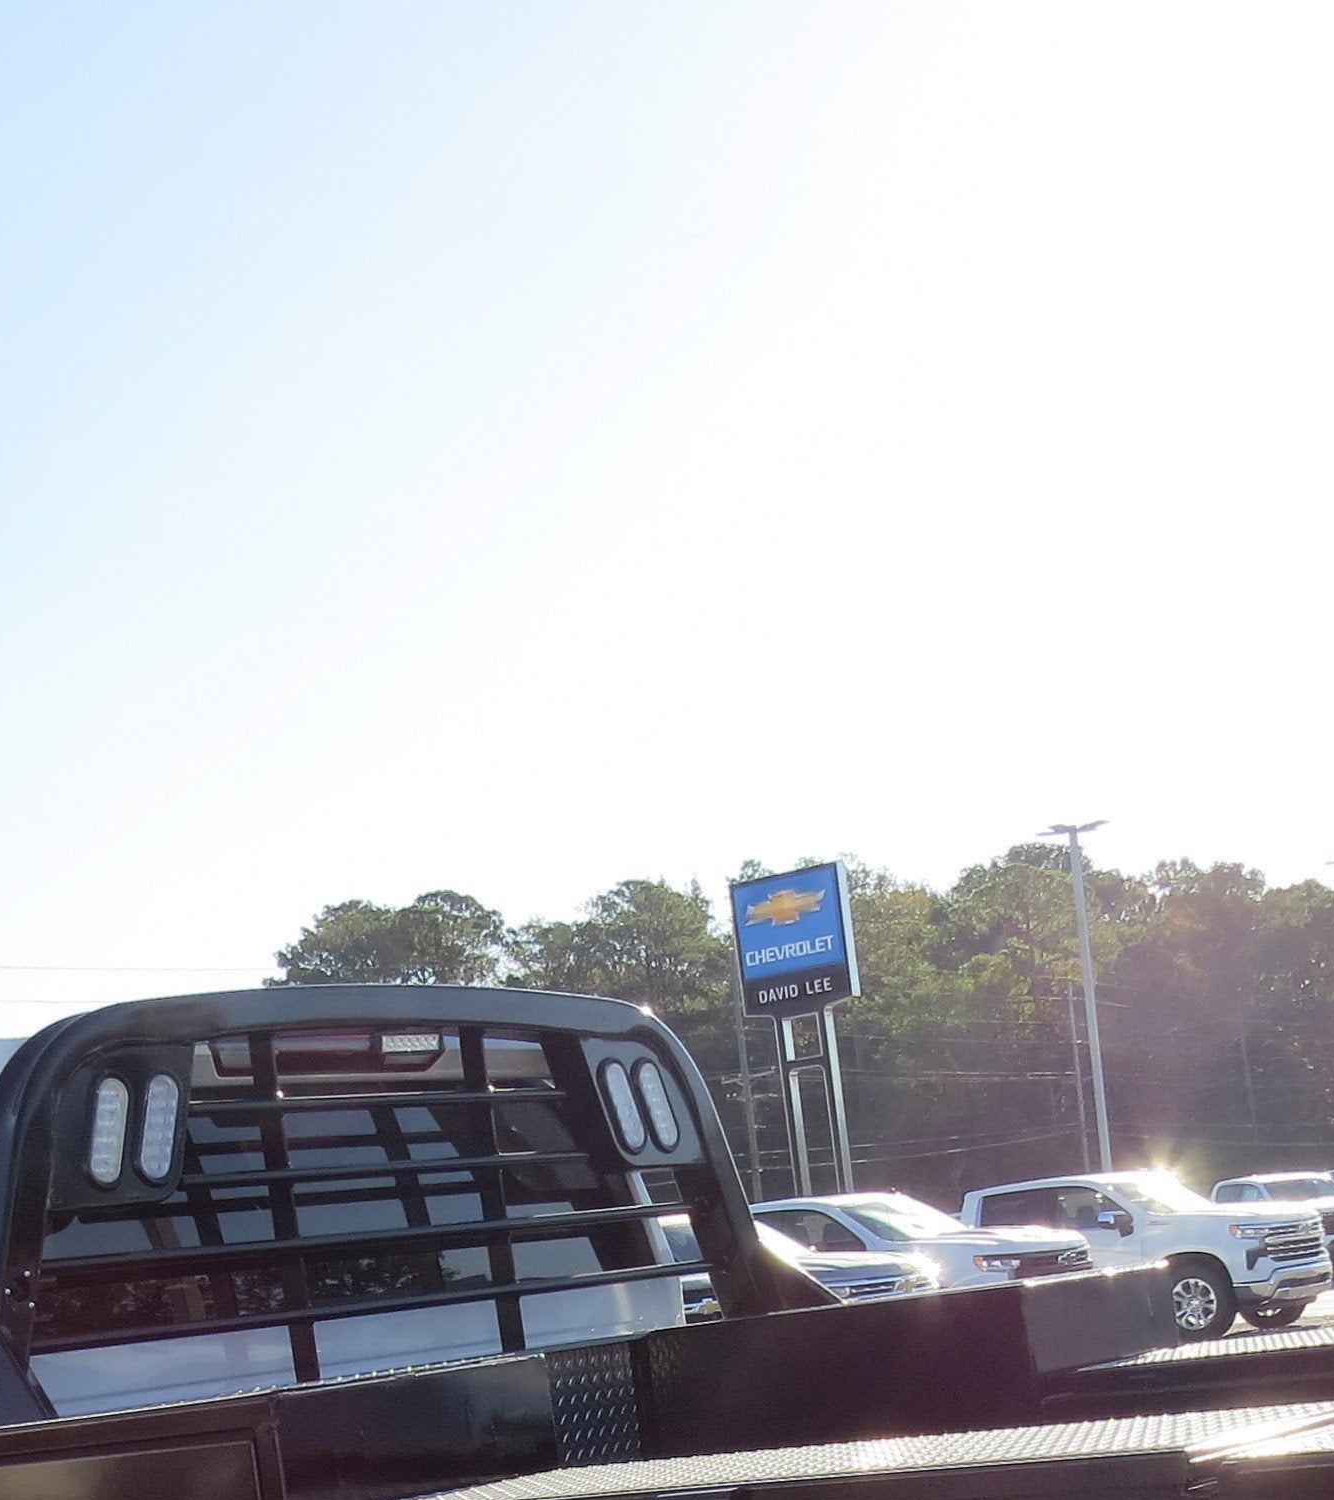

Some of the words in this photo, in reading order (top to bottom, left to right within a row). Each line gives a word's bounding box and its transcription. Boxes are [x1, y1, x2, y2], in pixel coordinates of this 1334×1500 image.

[745, 934, 834, 967] CHEVROLET
[759, 984, 798, 1004] DAVID
[806, 977, 832, 995] LEE
